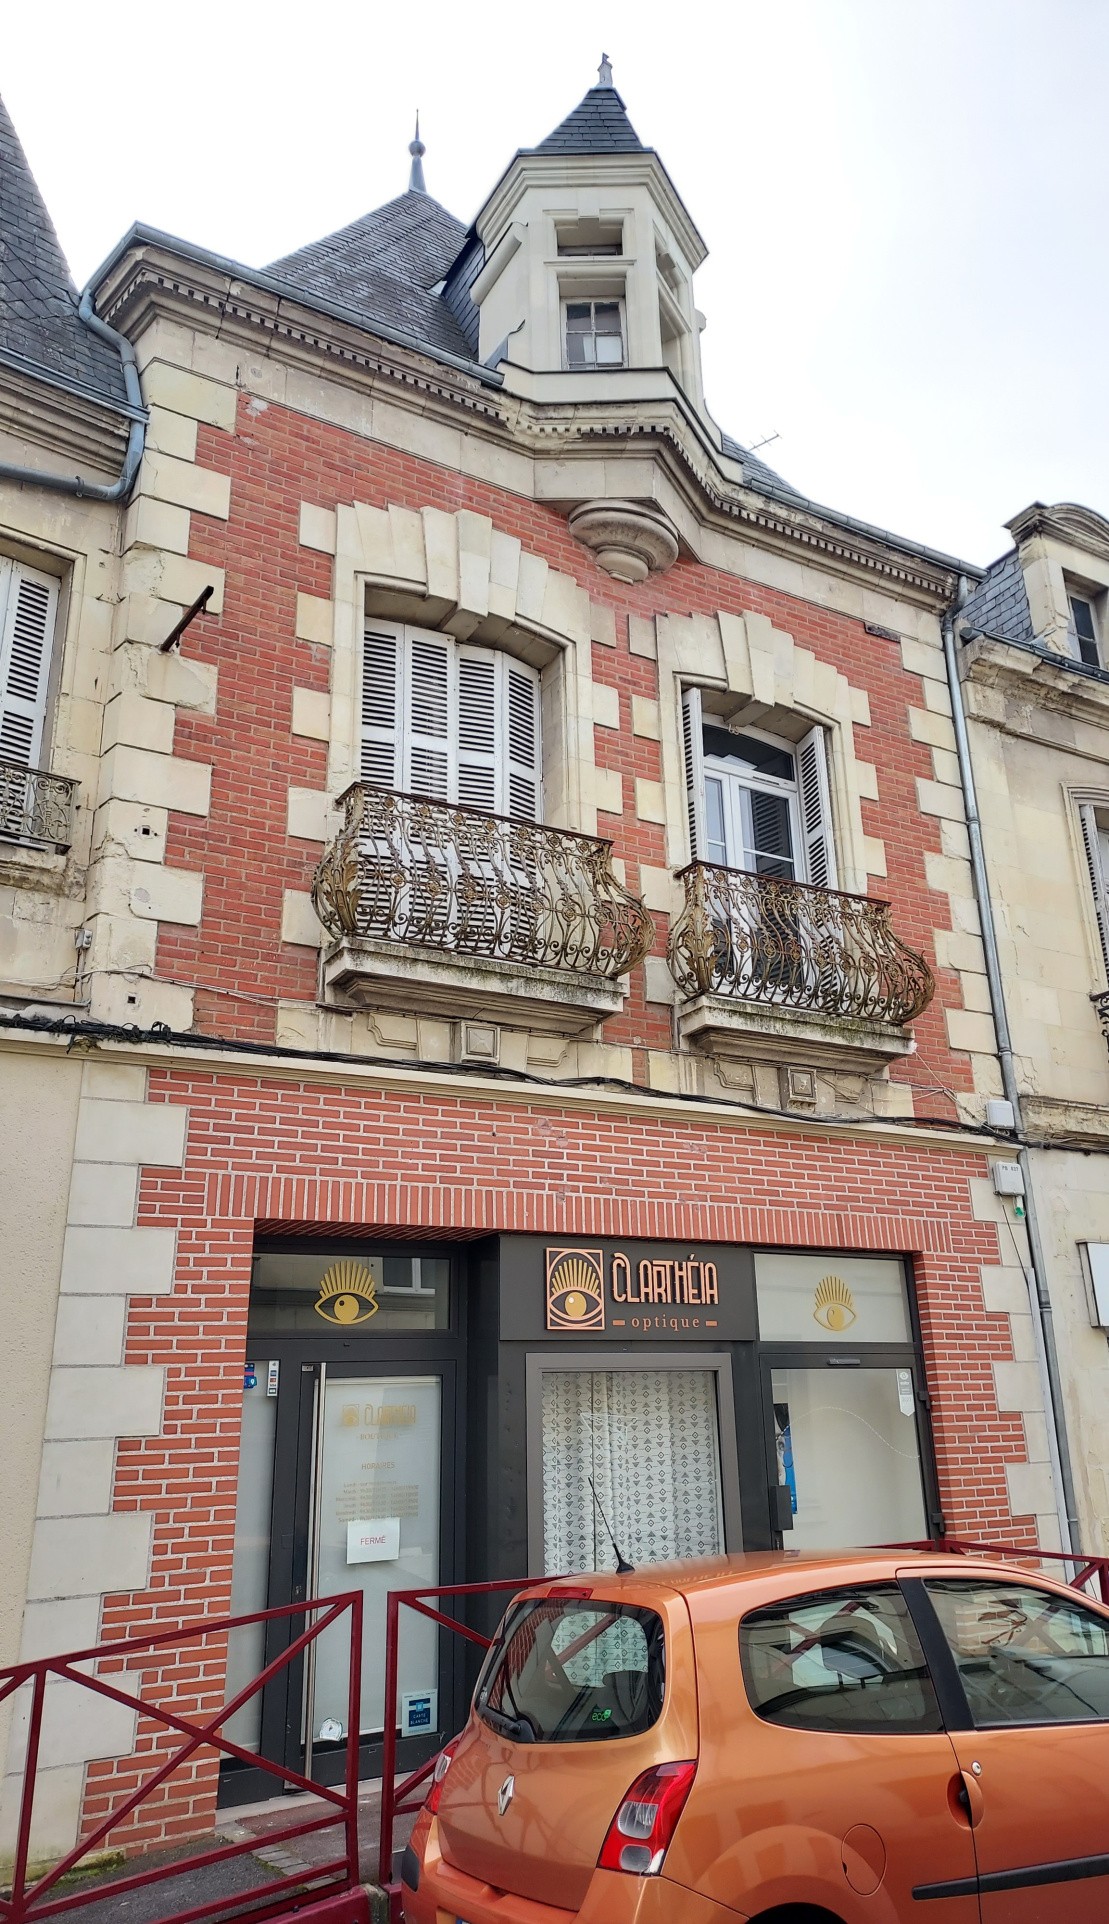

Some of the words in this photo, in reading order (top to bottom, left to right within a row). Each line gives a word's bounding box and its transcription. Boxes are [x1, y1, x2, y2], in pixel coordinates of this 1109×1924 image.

[612, 1252, 719, 1305] CLARTHÉIA
[631, 1314, 700, 1331] optique
[361, 1461, 396, 1470] HORAIRES
[360, 1535, 386, 1545] FERMÉ
